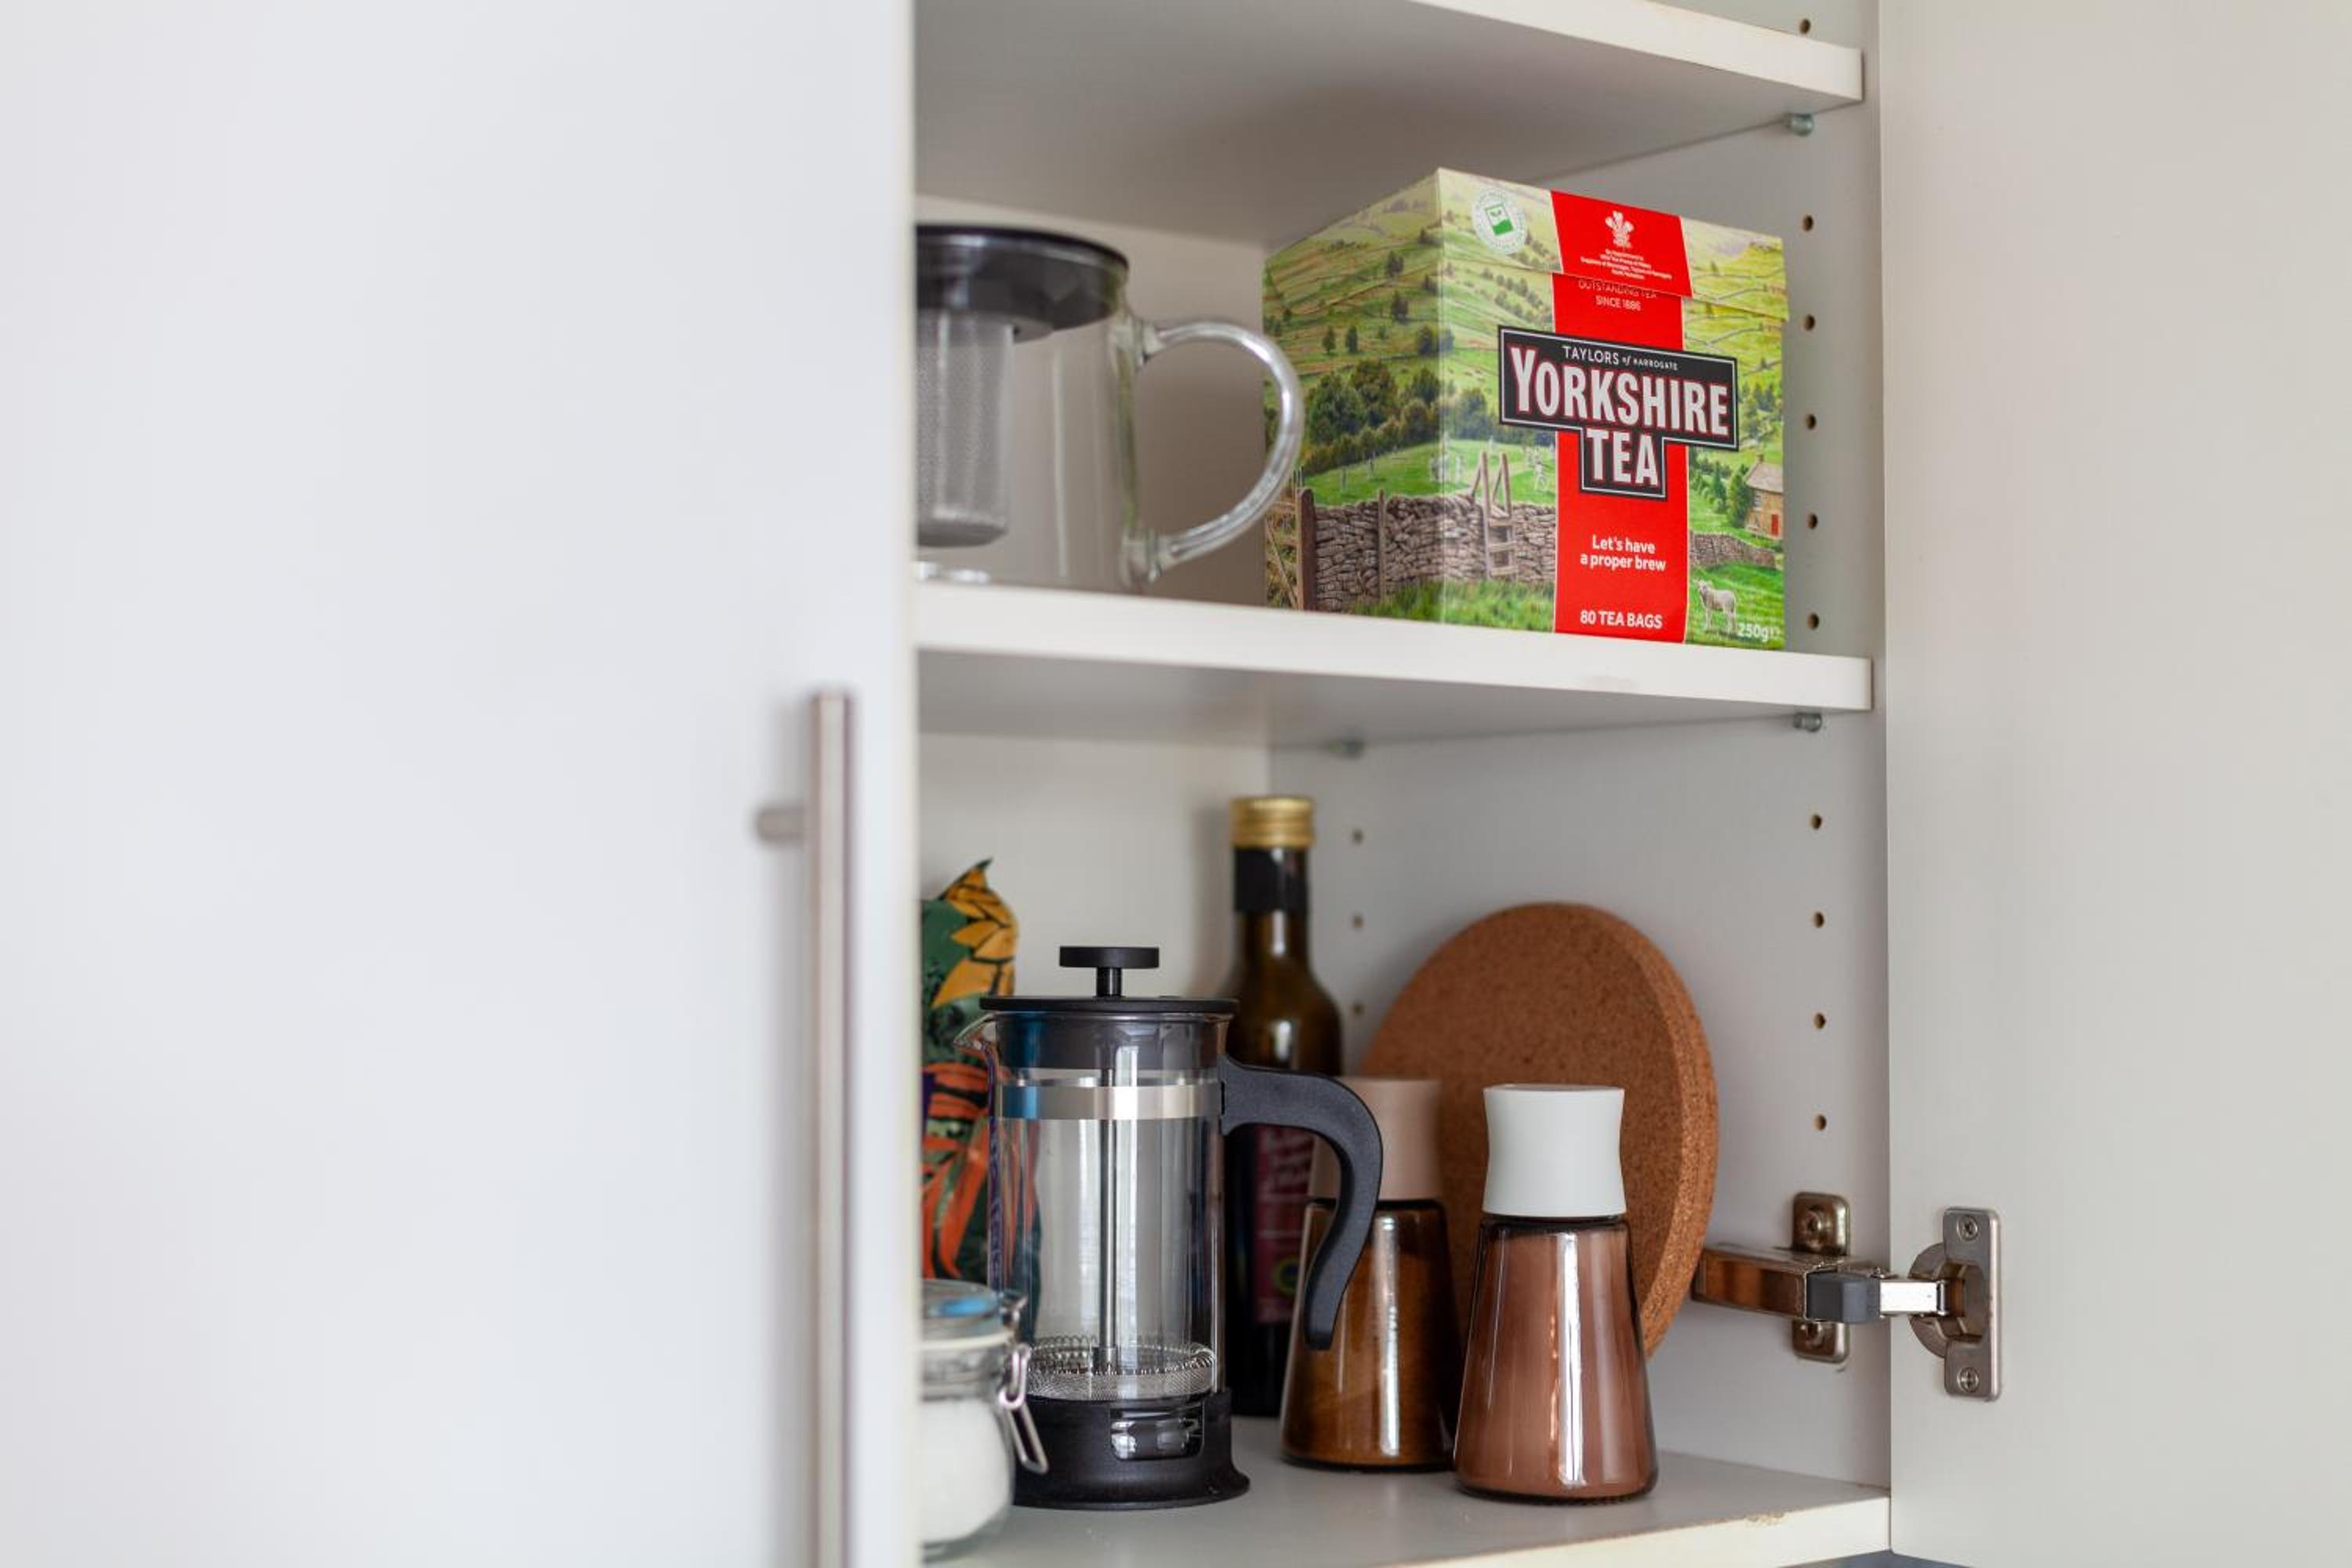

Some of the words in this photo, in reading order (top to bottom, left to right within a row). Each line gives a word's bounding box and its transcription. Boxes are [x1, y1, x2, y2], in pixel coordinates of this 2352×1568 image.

[1595, 295, 1621, 308] SINCE
[1622, 299, 1642, 311] 1886
[1562, 344, 1619, 365] TAYLORS
[1622, 355, 1631, 366] of
[1633, 358, 1678, 371] HARROGATE
[1510, 347, 1729, 435] YORKSHIRE
[1586, 428, 1658, 486] TEA
[1592, 534, 1624, 551] Let's
[1625, 537, 1656, 554] have
[1580, 554, 1588, 564] a
[1590, 554, 1632, 571] proper
[1635, 555, 1666, 571] brew
[1580, 610, 1596, 624] 80
[1598, 610, 1624, 626] TEA
[1627, 612, 1663, 629] BAGS
